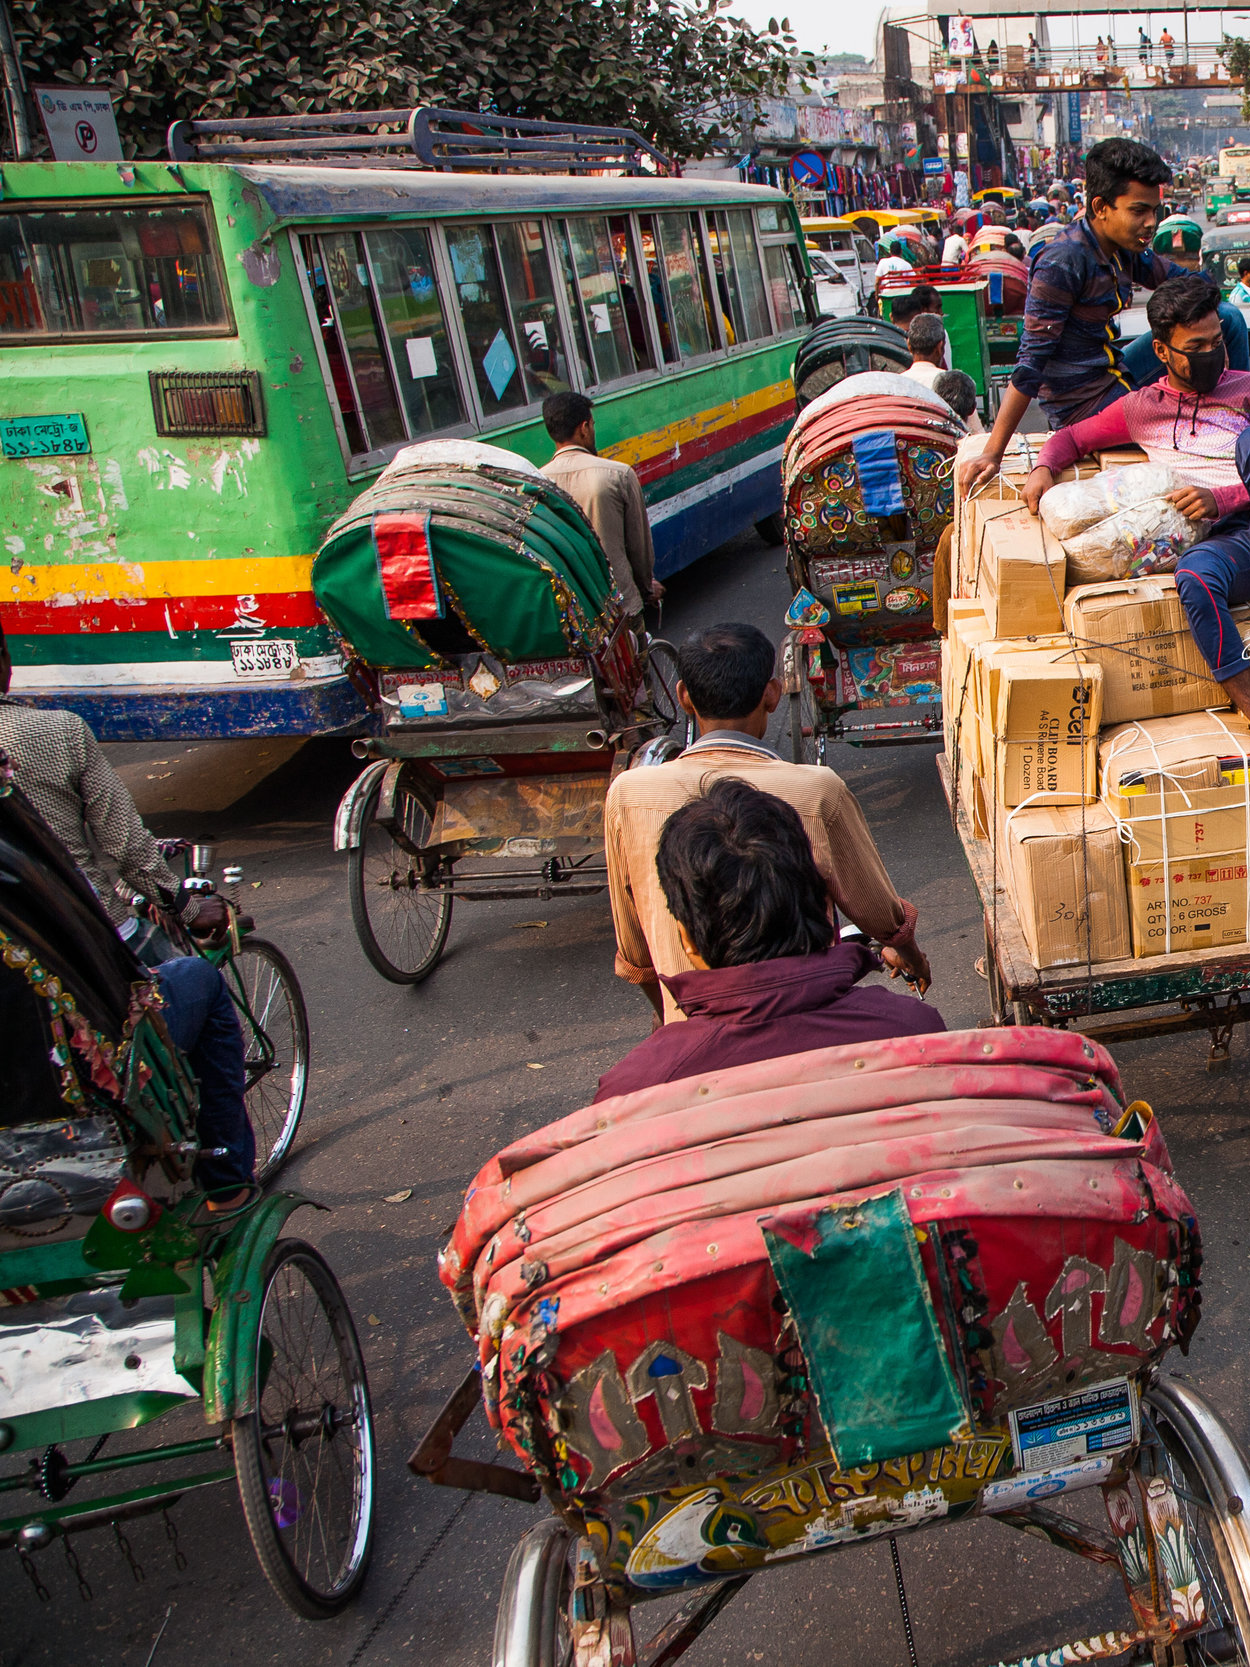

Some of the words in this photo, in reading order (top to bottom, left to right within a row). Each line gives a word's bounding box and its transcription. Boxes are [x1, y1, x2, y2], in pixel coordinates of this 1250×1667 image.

[6, 425, 31, 437] ঢাকা
[5, 439, 85, 456] ১১-১৮৪৮
[229, 644, 255, 657] ঢাকা
[1155, 642, 1176, 651] GROSS
[1040, 710, 1050, 721] A4
[1038, 721, 1048, 730] S
[1023, 755, 1033, 790] Dozen
[1047, 747, 1058, 791] BOARD
[1036, 767, 1046, 791] Boad
[1195, 822, 1204, 843] 737
[1172, 898, 1191, 908] NO.
[1194, 895, 1212, 905] 737
[1178, 912, 1185, 920] 6
[1188, 906, 1227, 919] GROSS
